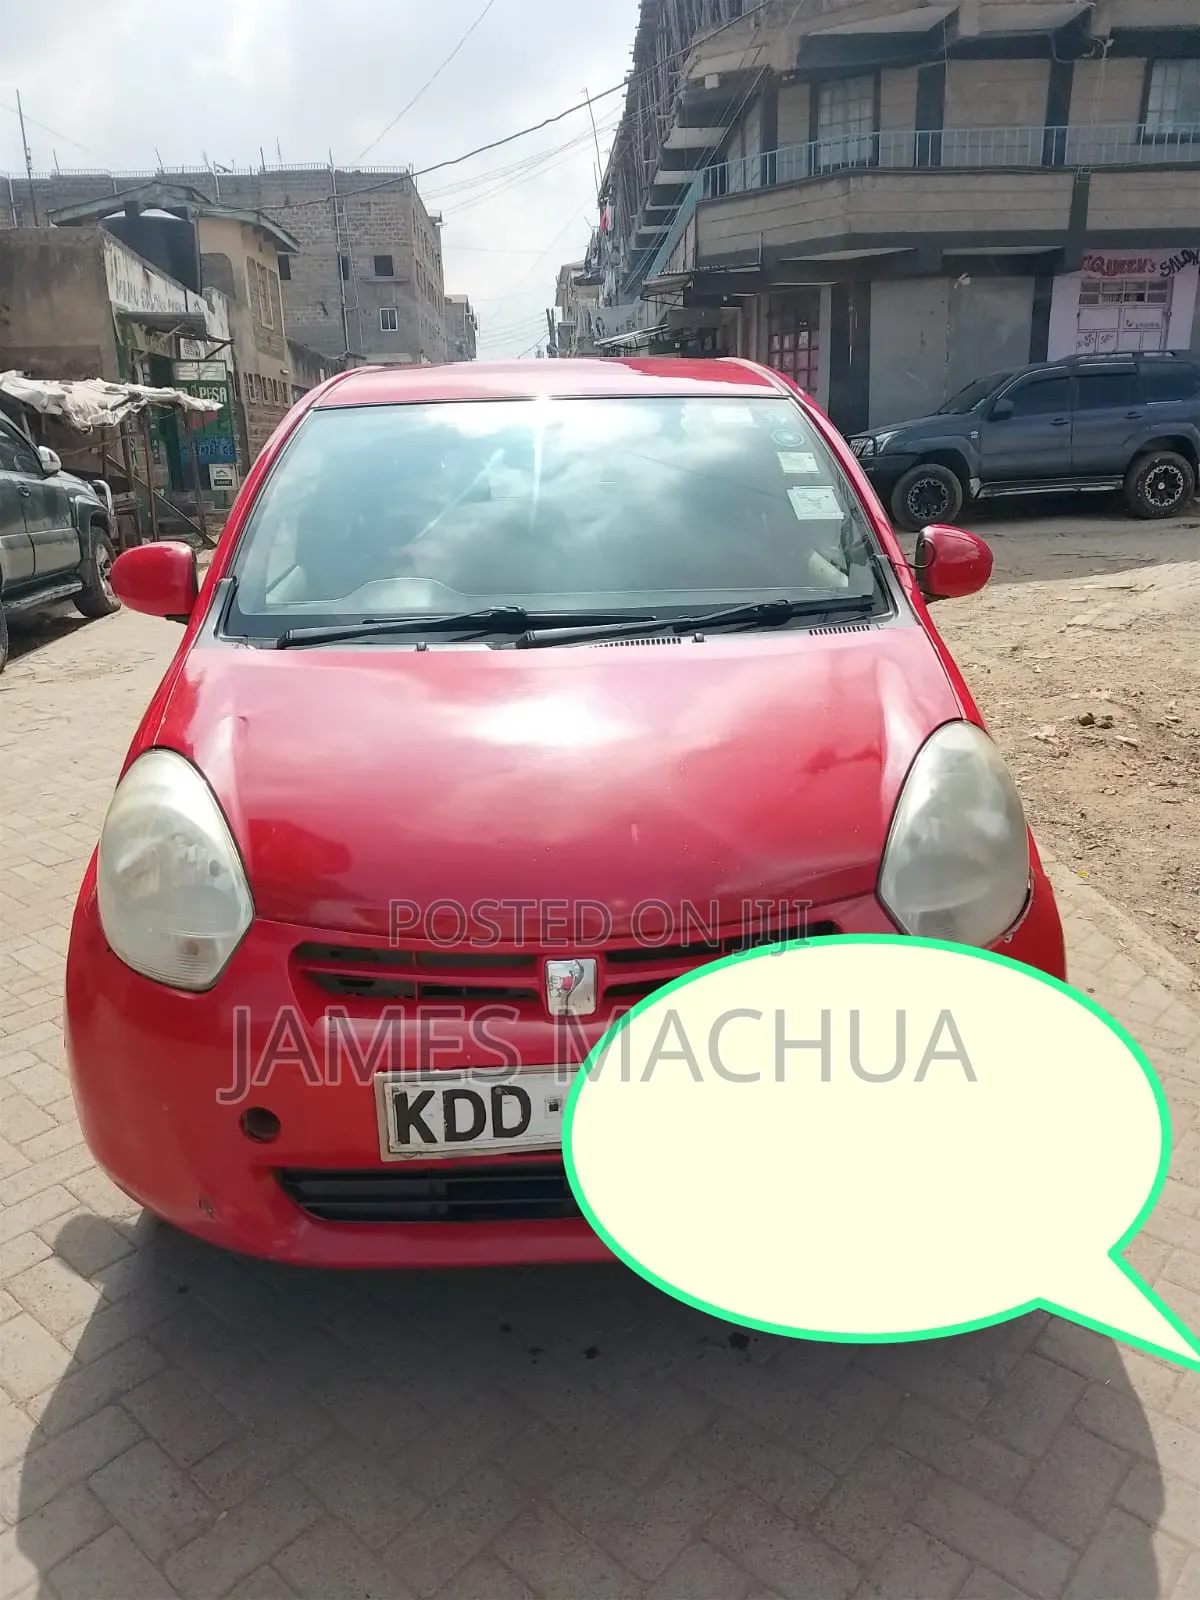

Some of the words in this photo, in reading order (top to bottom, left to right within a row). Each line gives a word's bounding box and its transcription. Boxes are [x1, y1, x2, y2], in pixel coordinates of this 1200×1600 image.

[1160, 249, 1200, 277] SALON
[199, 386, 228, 403] PESA
[394, 1085, 532, 1145] KDD
